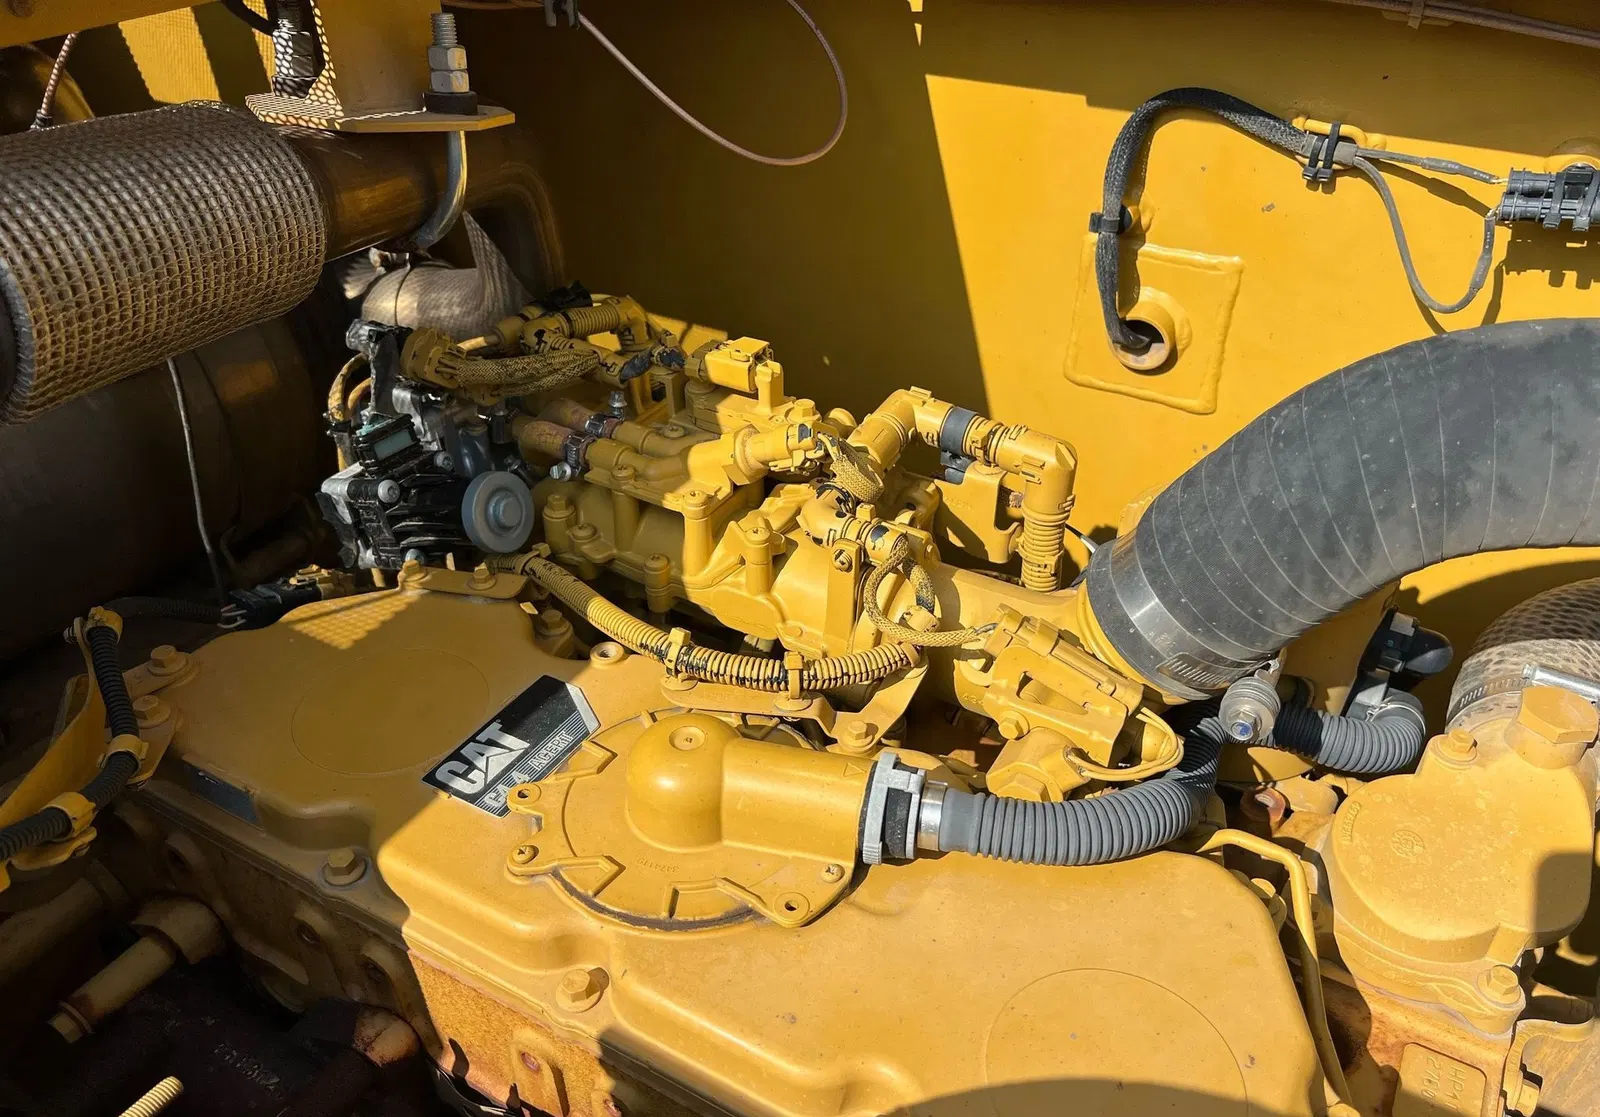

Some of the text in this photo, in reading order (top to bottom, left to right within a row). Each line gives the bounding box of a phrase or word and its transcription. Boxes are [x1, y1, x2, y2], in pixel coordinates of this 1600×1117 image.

[435, 721, 531, 794] CAT
[484, 730, 574, 808] C44 ACERT
